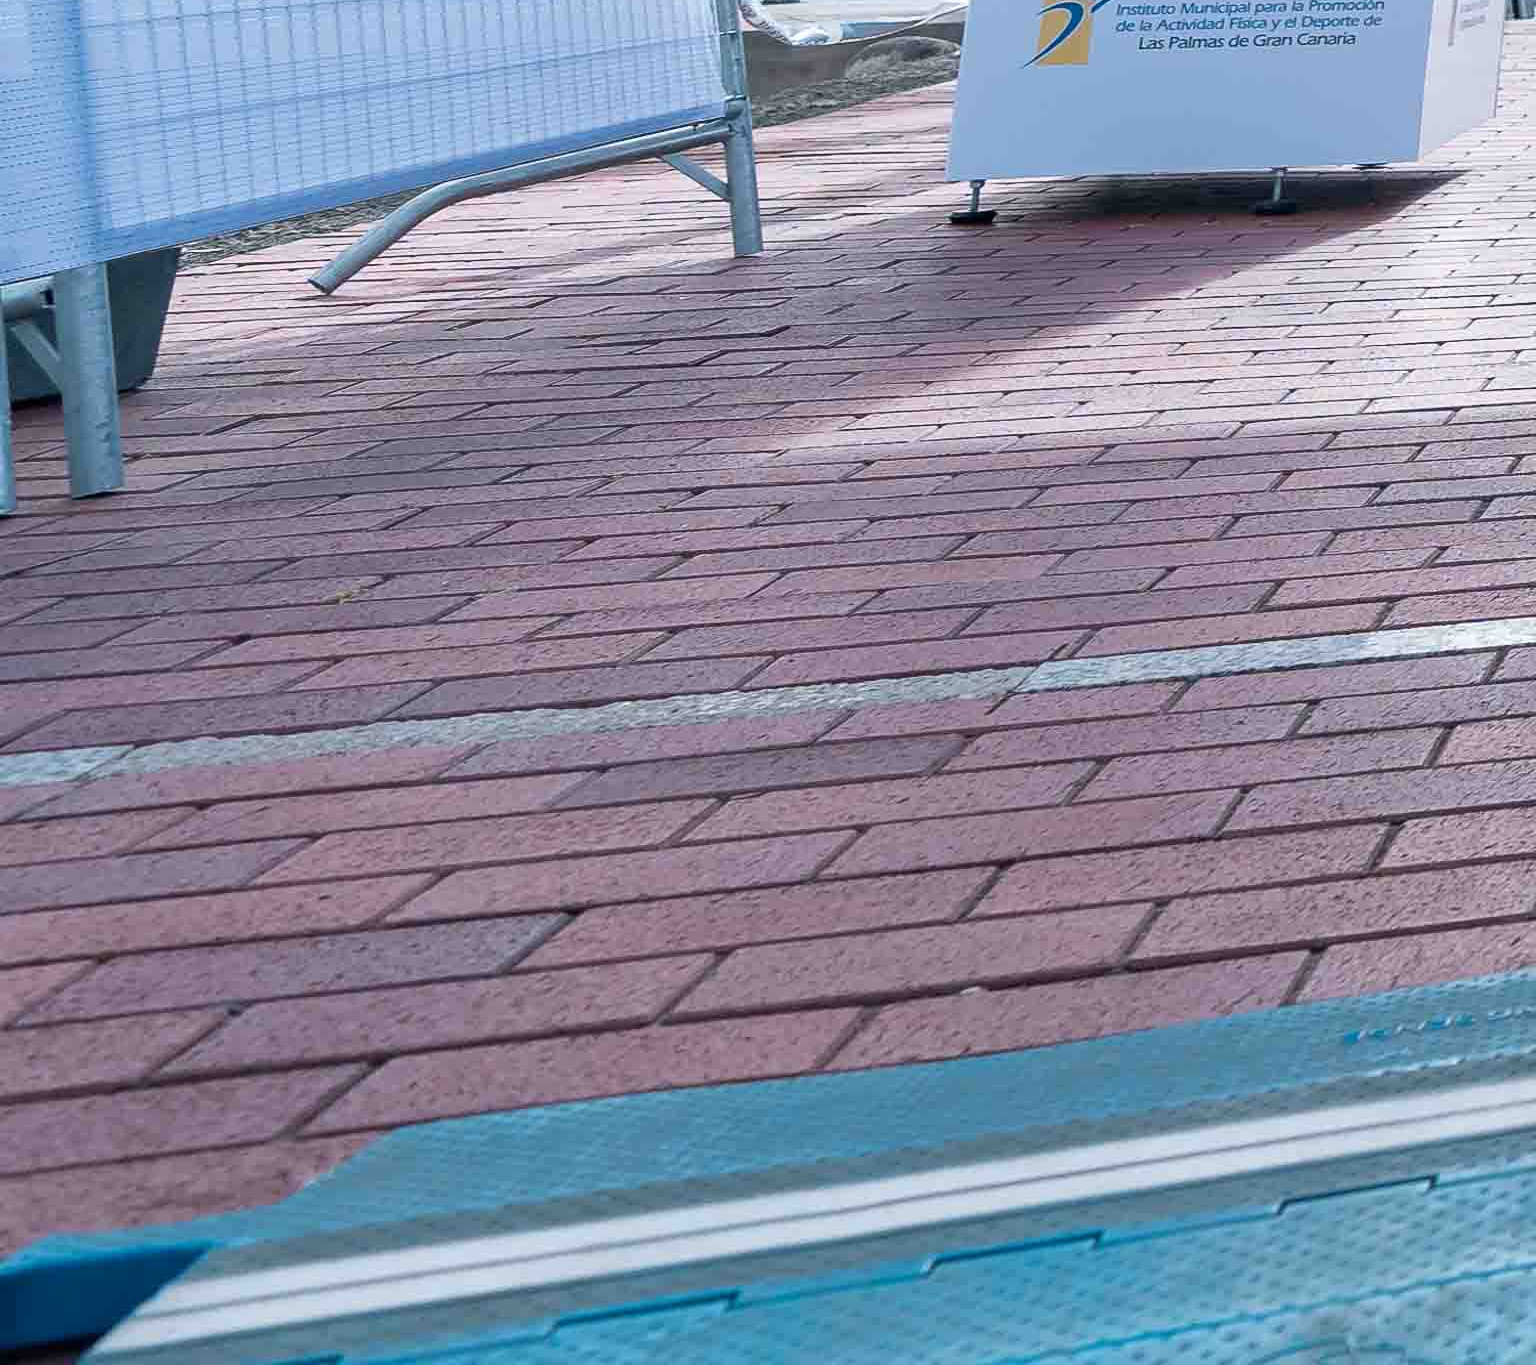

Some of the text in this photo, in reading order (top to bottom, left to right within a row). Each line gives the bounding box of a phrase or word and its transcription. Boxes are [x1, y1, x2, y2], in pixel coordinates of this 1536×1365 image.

[1116, 0, 1384, 16] Instituto Municipal para la Promoción
[1138, 32, 1355, 49] Las Palmas de Gran Canaria
